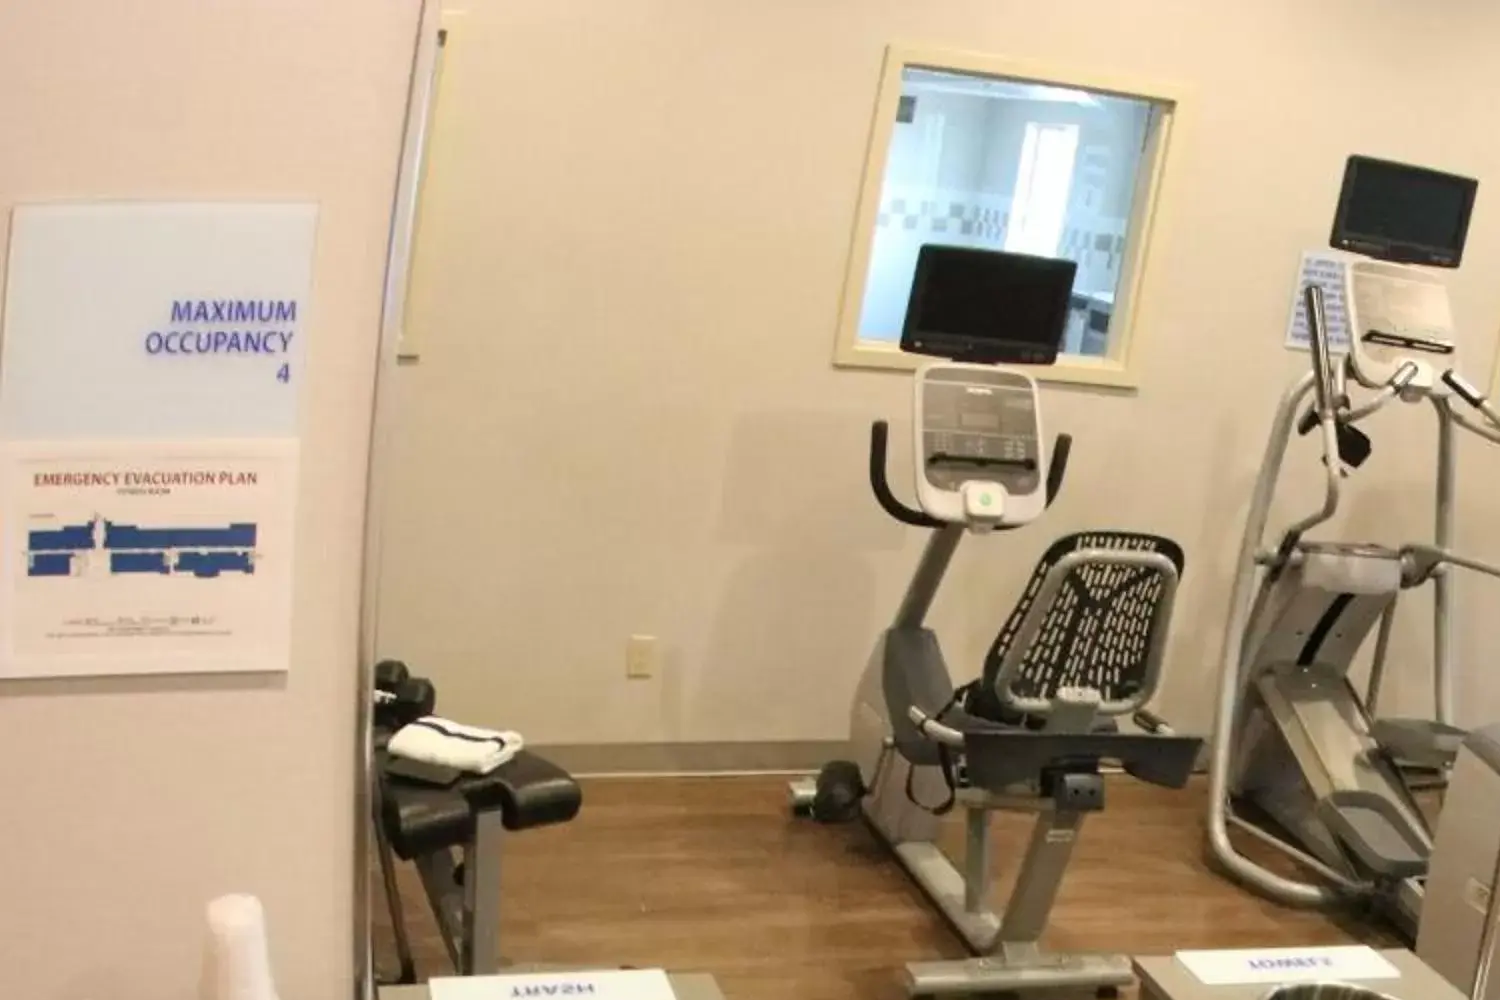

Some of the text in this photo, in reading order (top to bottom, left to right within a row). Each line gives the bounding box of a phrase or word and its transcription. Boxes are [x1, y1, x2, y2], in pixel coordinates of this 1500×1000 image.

[170, 300, 297, 323] MAXIMUM
[144, 331, 294, 355] OCCUPANCY
[276, 362, 291, 384] 4
[33, 471, 258, 488] EMERGENCY EVACUATION PLAN
